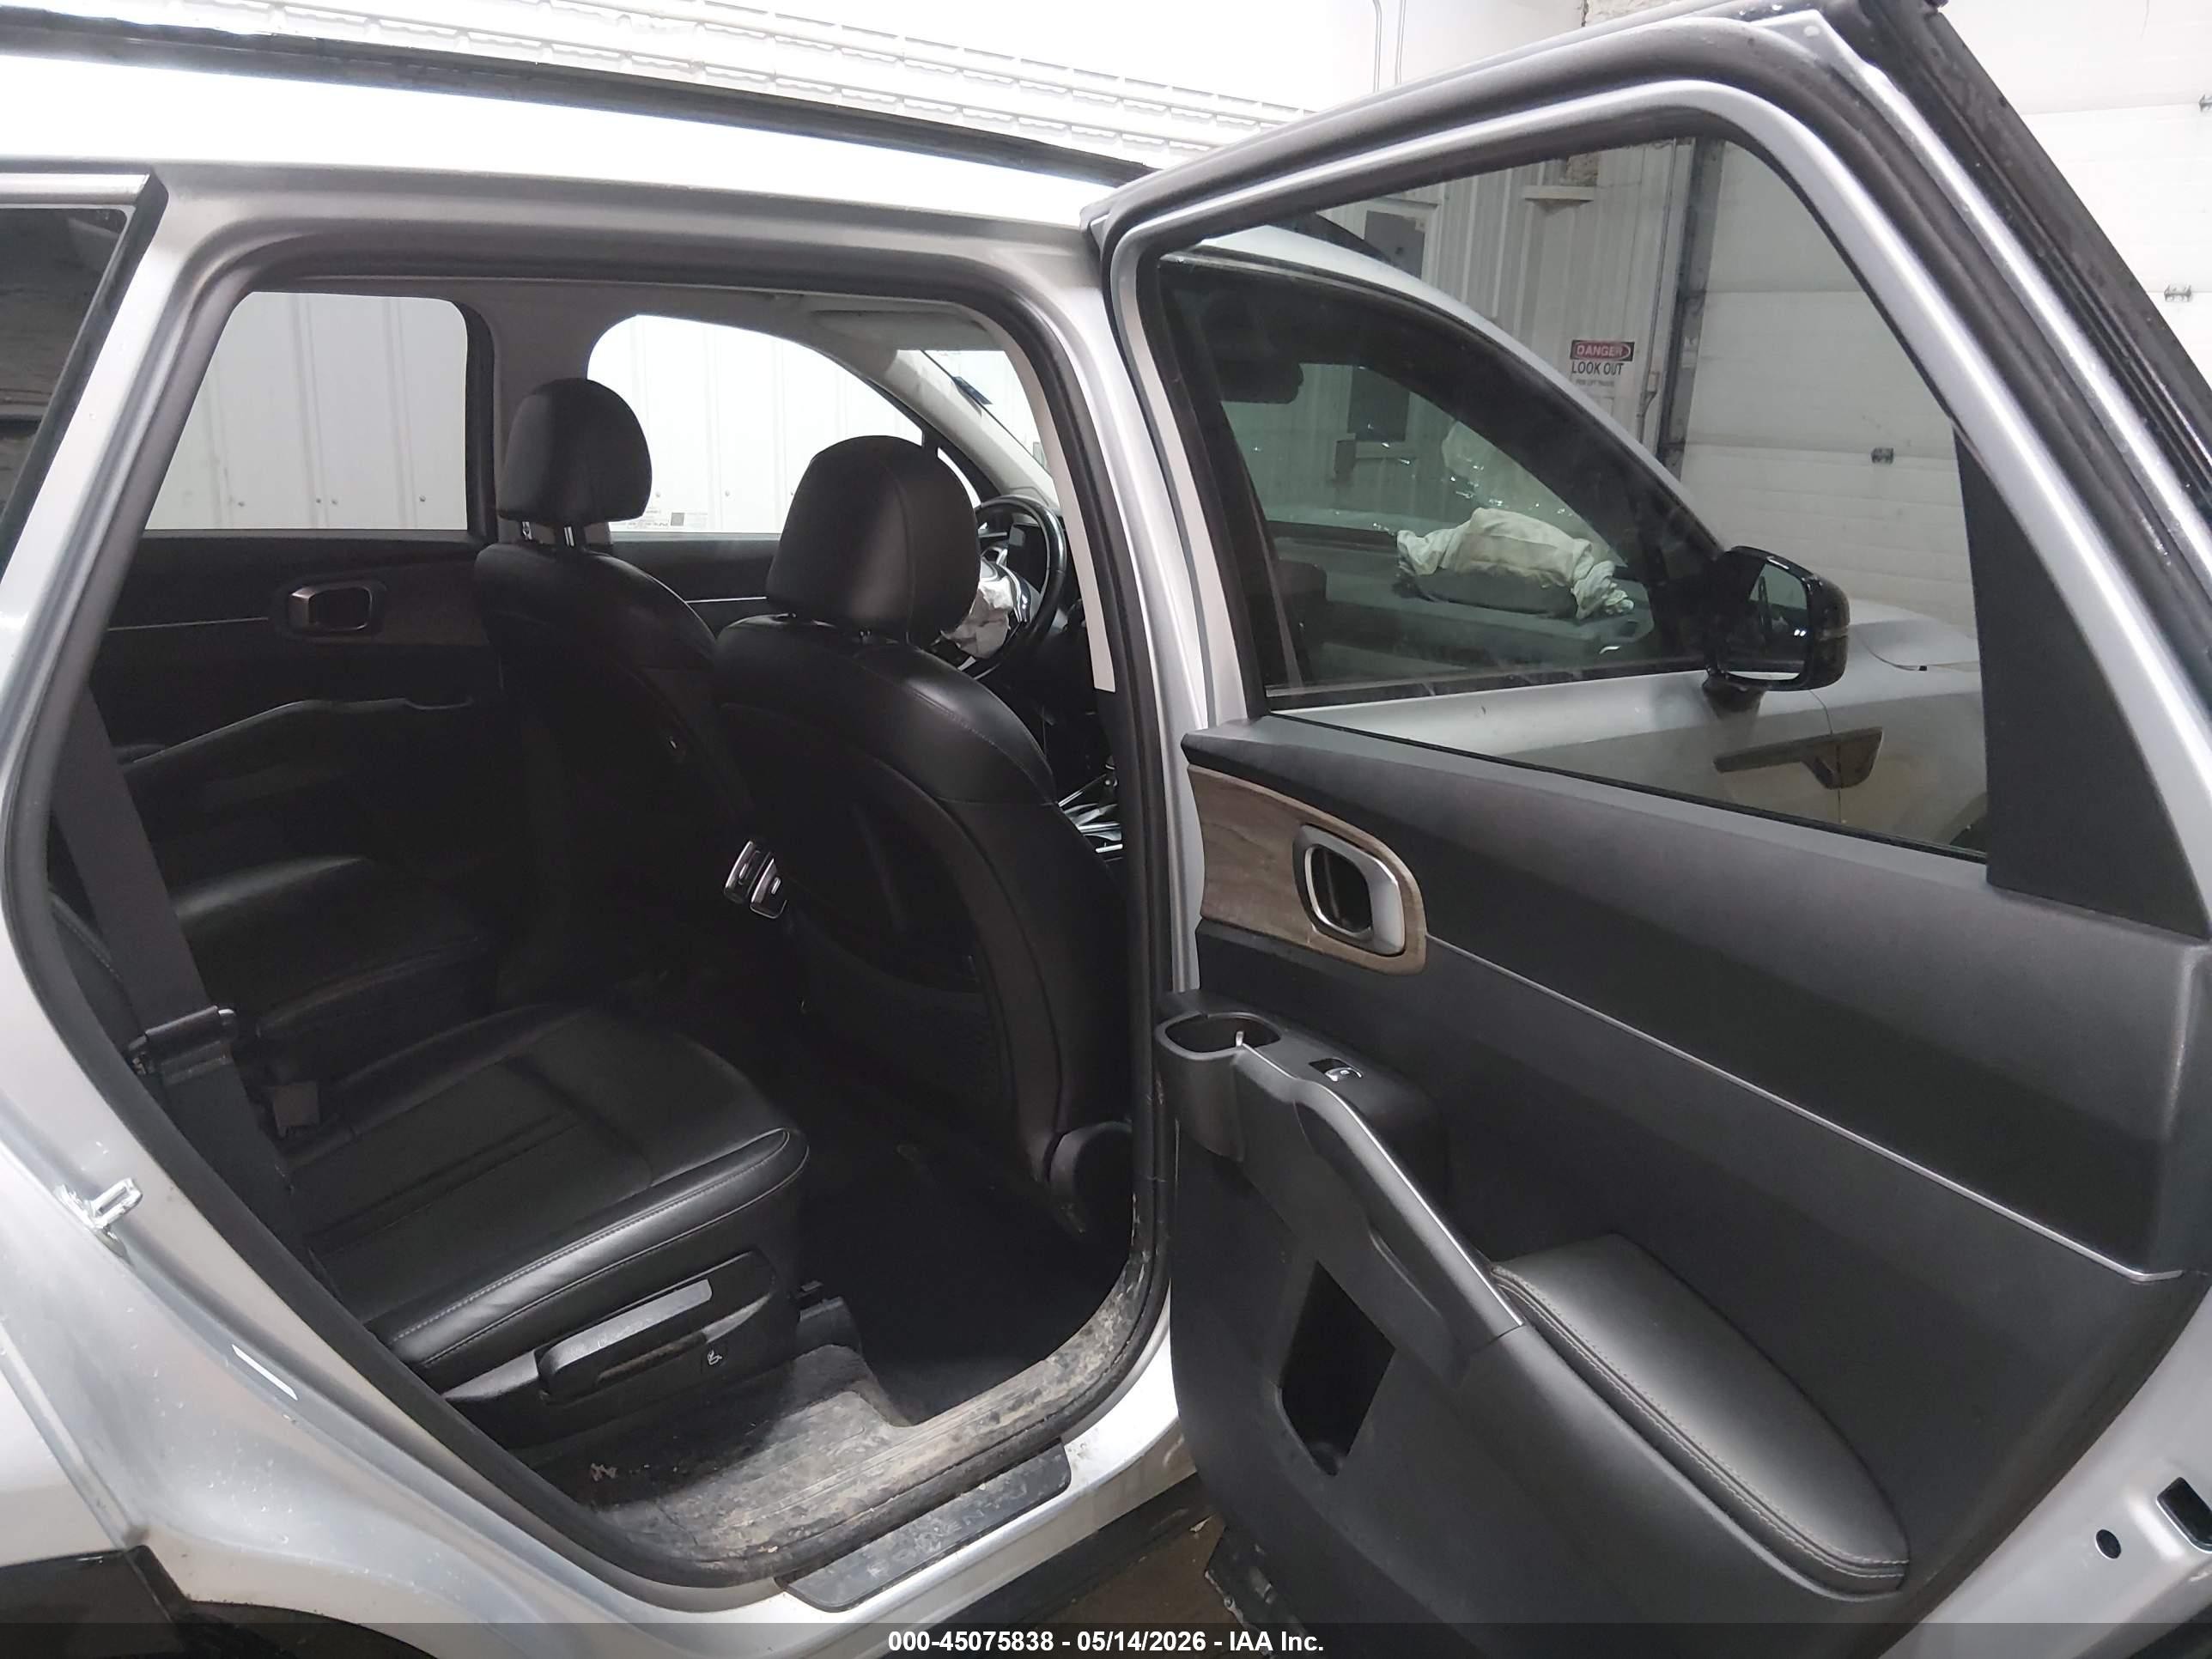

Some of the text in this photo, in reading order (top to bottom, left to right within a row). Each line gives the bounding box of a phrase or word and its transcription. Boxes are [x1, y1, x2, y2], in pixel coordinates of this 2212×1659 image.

[1577, 345, 1623, 358] DANGER
[1571, 362, 1624, 375] LOOK OUT
